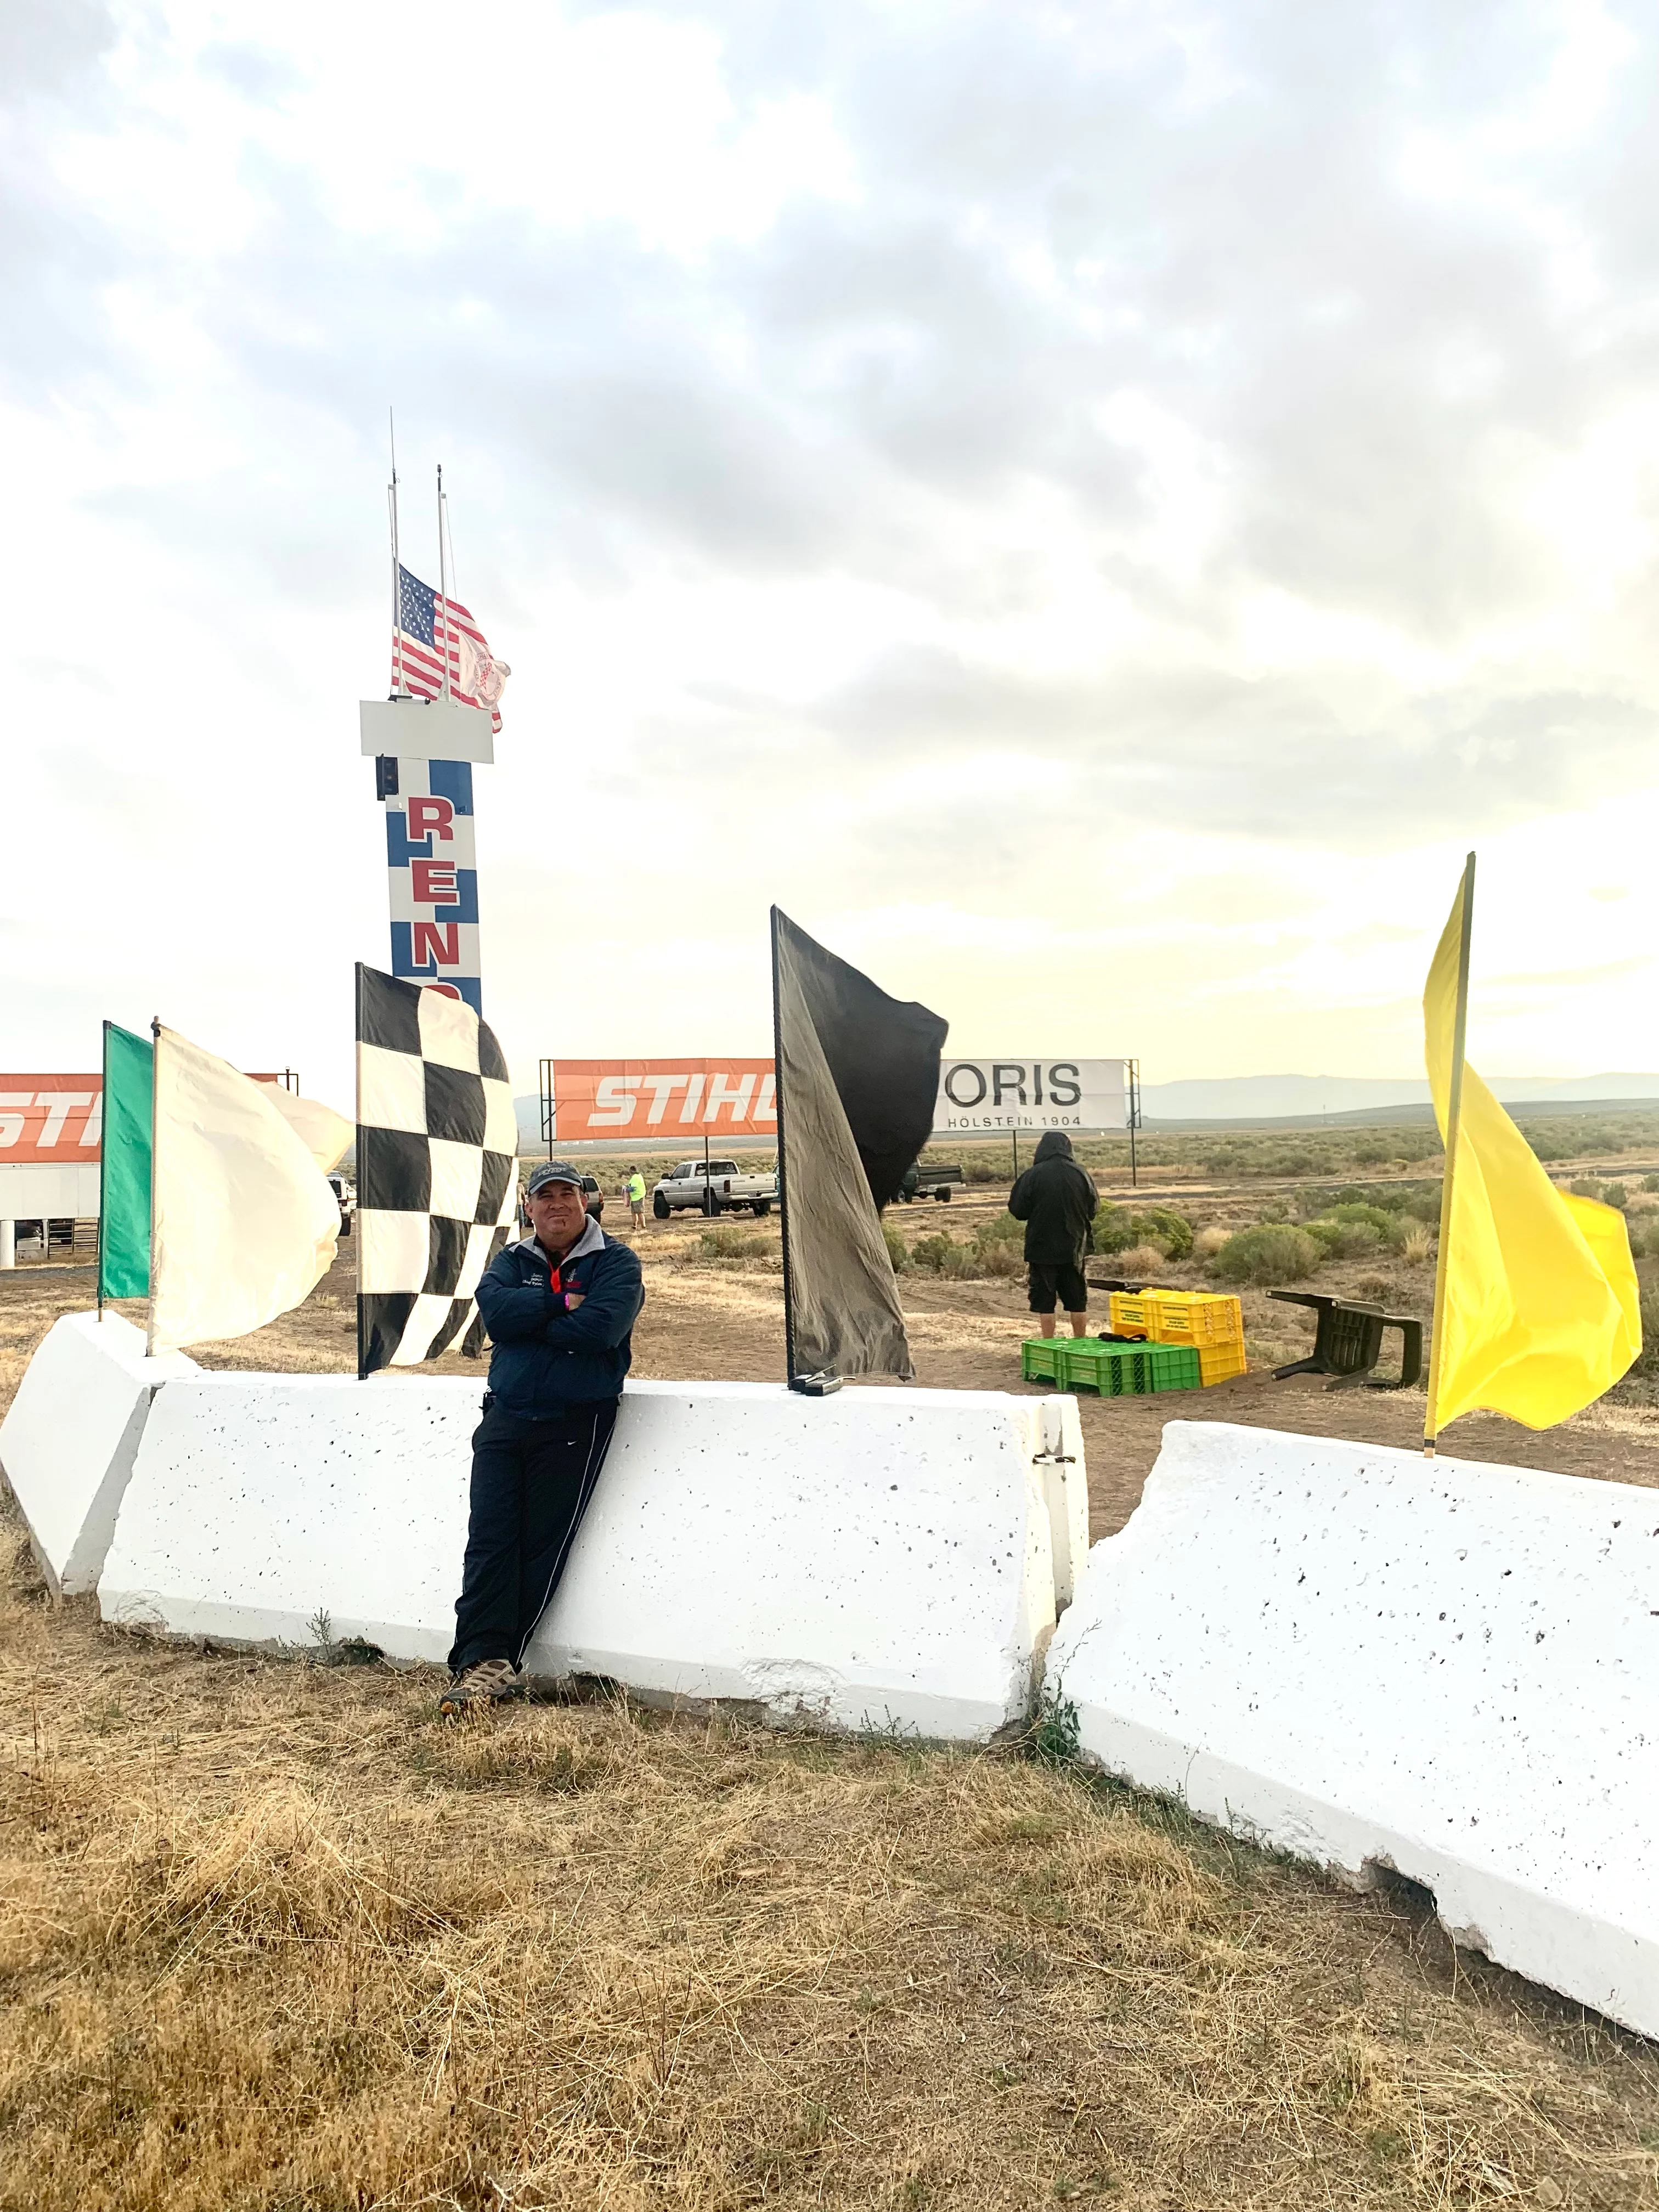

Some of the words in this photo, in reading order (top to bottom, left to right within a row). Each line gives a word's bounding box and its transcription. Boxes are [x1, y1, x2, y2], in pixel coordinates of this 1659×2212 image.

[408, 797, 460, 1000] REN
[586, 1073, 777, 1127] STIHL
[945, 1064, 1081, 1108] ORIS
[947, 1116, 1032, 1127] HÖLSTEIN
[1042, 1116, 1081, 1126] 1904
